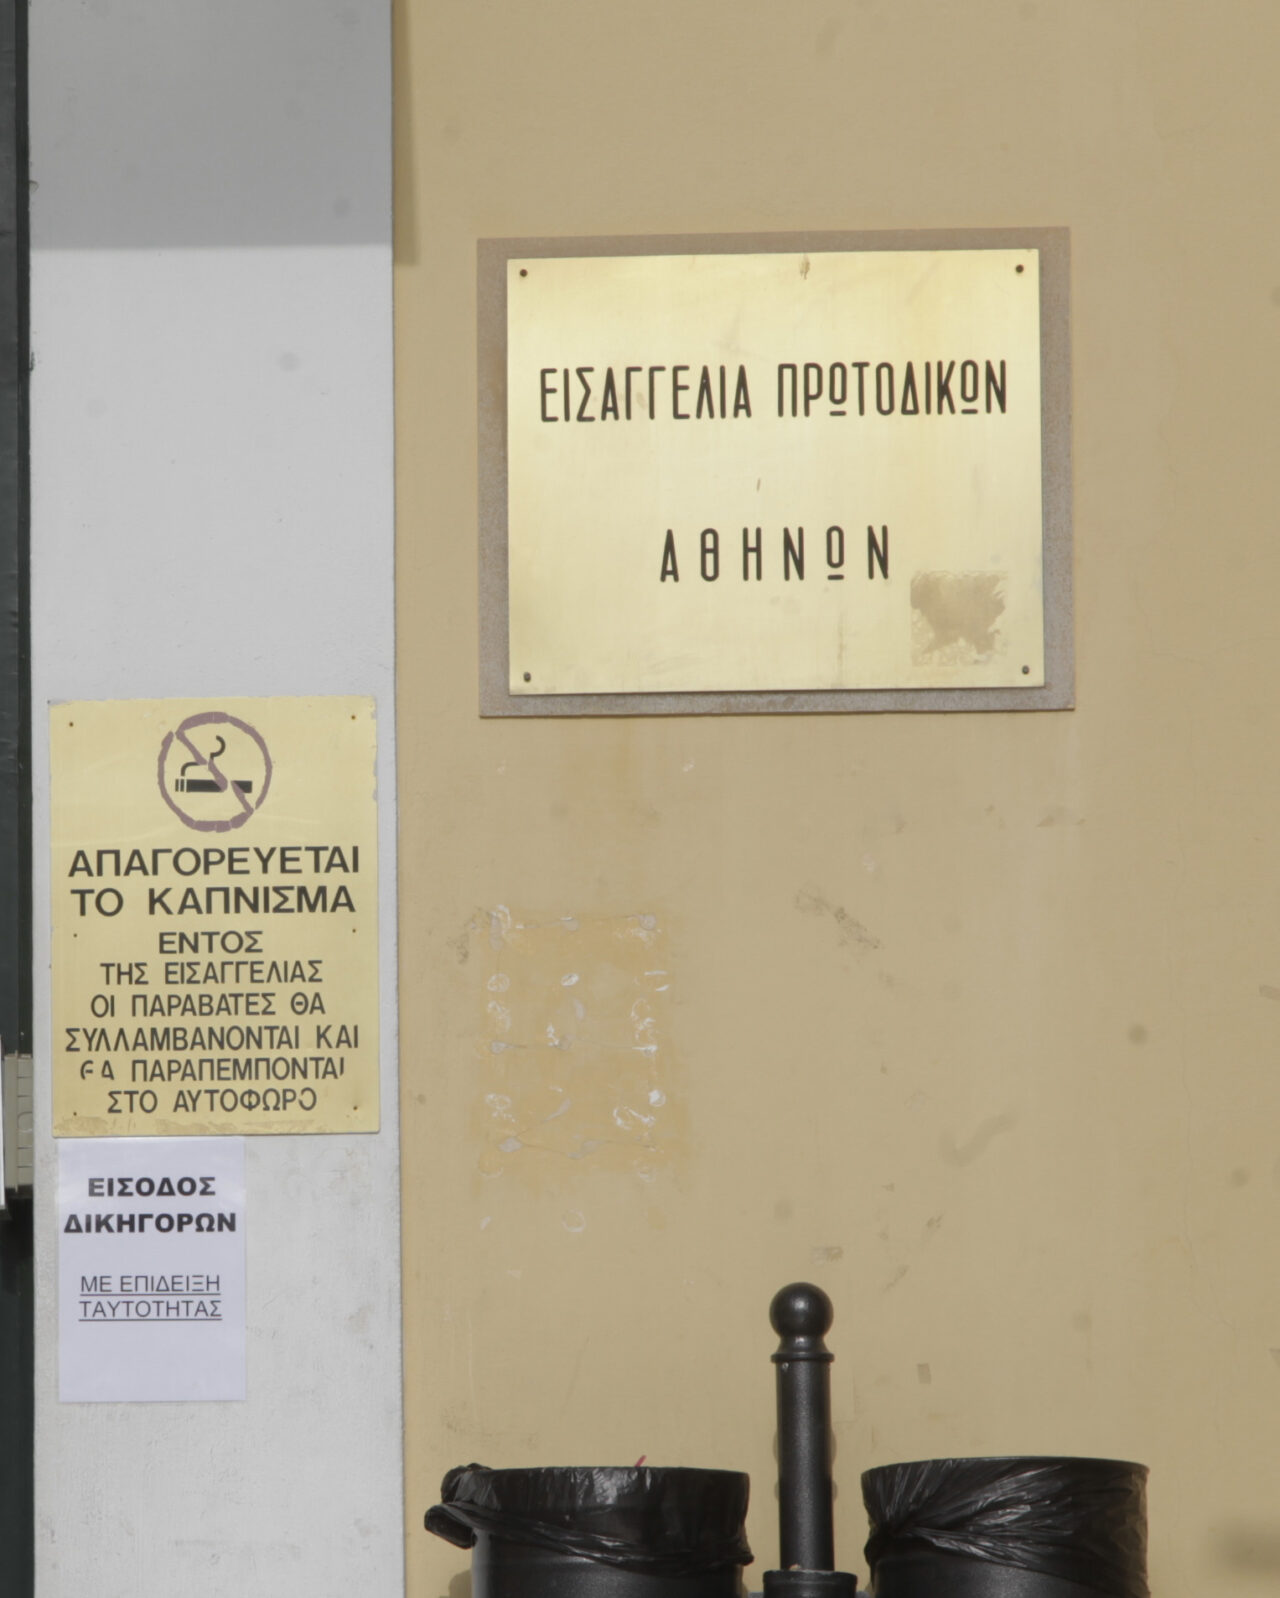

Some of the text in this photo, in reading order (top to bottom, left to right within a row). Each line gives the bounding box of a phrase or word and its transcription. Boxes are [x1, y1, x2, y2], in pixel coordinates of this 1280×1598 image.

[540, 359, 1008, 423] ΕΙΣΑΓΓΕΛΙΑ ΠΡΩΤΟΔΙΚΩΝ
[659, 524, 890, 583] ΑΘΗΝΩΝ
[67, 845, 360, 878] ΑΠΑΓΟΡΕΥΕΤΑΙ
[70, 885, 357, 917] ΤΟ ΚΑΠΝΙΣΜΑ
[158, 930, 264, 955] ΕΝΤΟΣ
[100, 960, 324, 986] ΤΗΣ ΕΙΣΑΓΓΕΛΙΑΣ
[90, 991, 326, 1018] ΟΙ ΠΑΡΑΒΑΤΕΣ ΘΑ
[65, 1024, 359, 1053] ΣΥΛΛΑΜΒΑΝΟΝΤΑΙ ΚΑΙ
[130, 1056, 345, 1082] ΠΑΡΑΠΕΜΠΟΝΤΑΙ
[107, 1087, 317, 1115] ΣΤΟ ΑΥΤΟΦΩΡΟ
[87, 1176, 217, 1198] ΕΙΣΟΔΟΣ
[63, 1212, 237, 1234] ΔΙΚΗΓΟΡΩΝ
[80, 1274, 220, 1294] ΜΕ ΕΠΙΔΕΙΞΗ
[79, 1299, 222, 1319] ΤΑΥΤΟΤΗΤΑΣ
